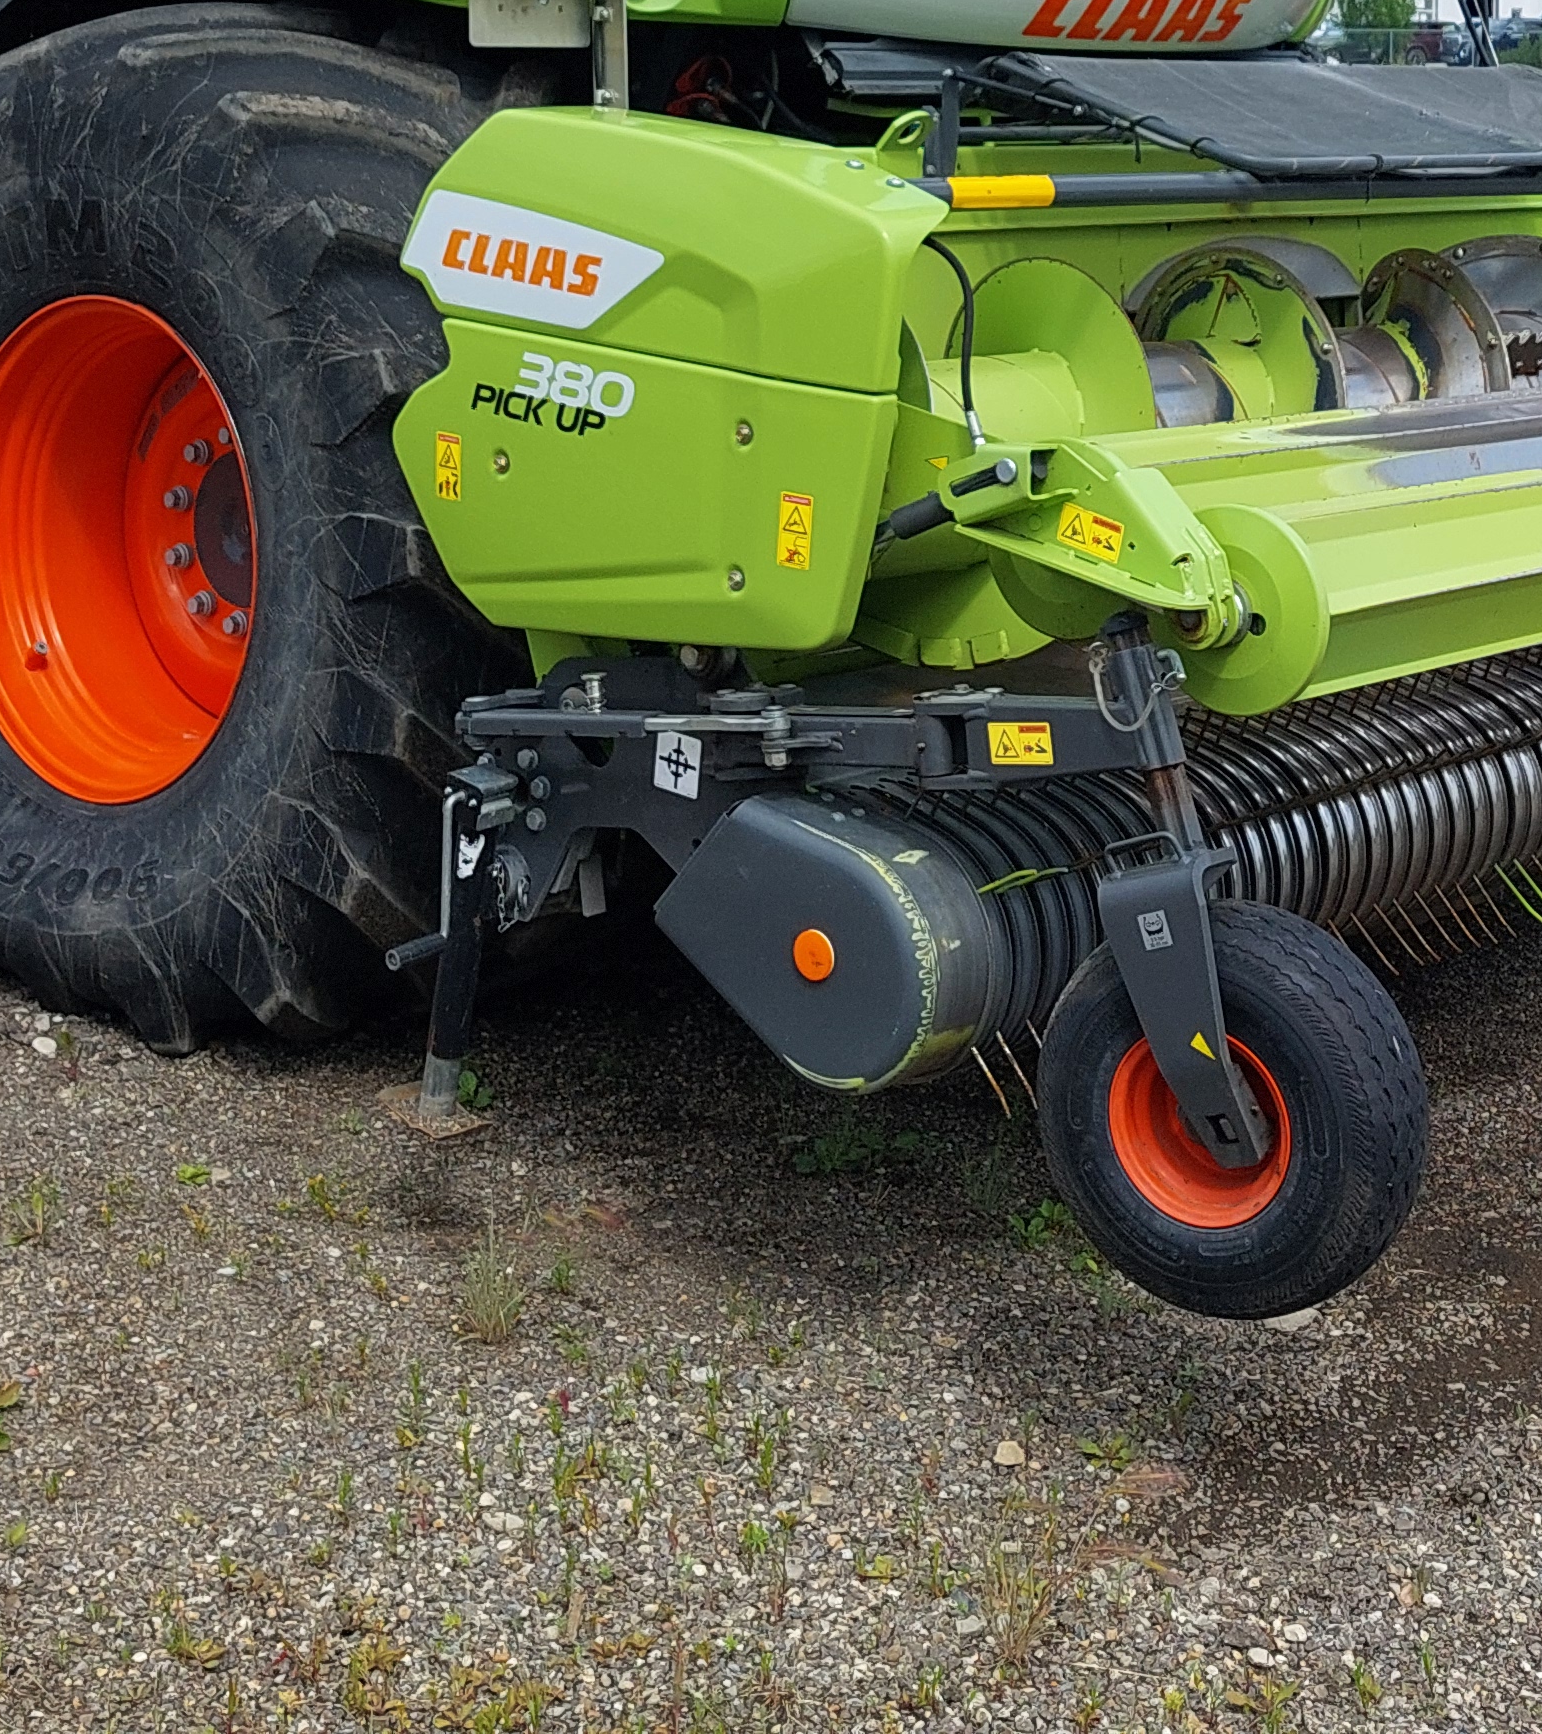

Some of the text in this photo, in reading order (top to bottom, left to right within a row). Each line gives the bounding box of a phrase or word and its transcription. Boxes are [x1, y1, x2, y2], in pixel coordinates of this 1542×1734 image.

[441, 228, 603, 297] CLAAS
[470, 382, 607, 437] PICK UP
[513, 351, 635, 418] 380
